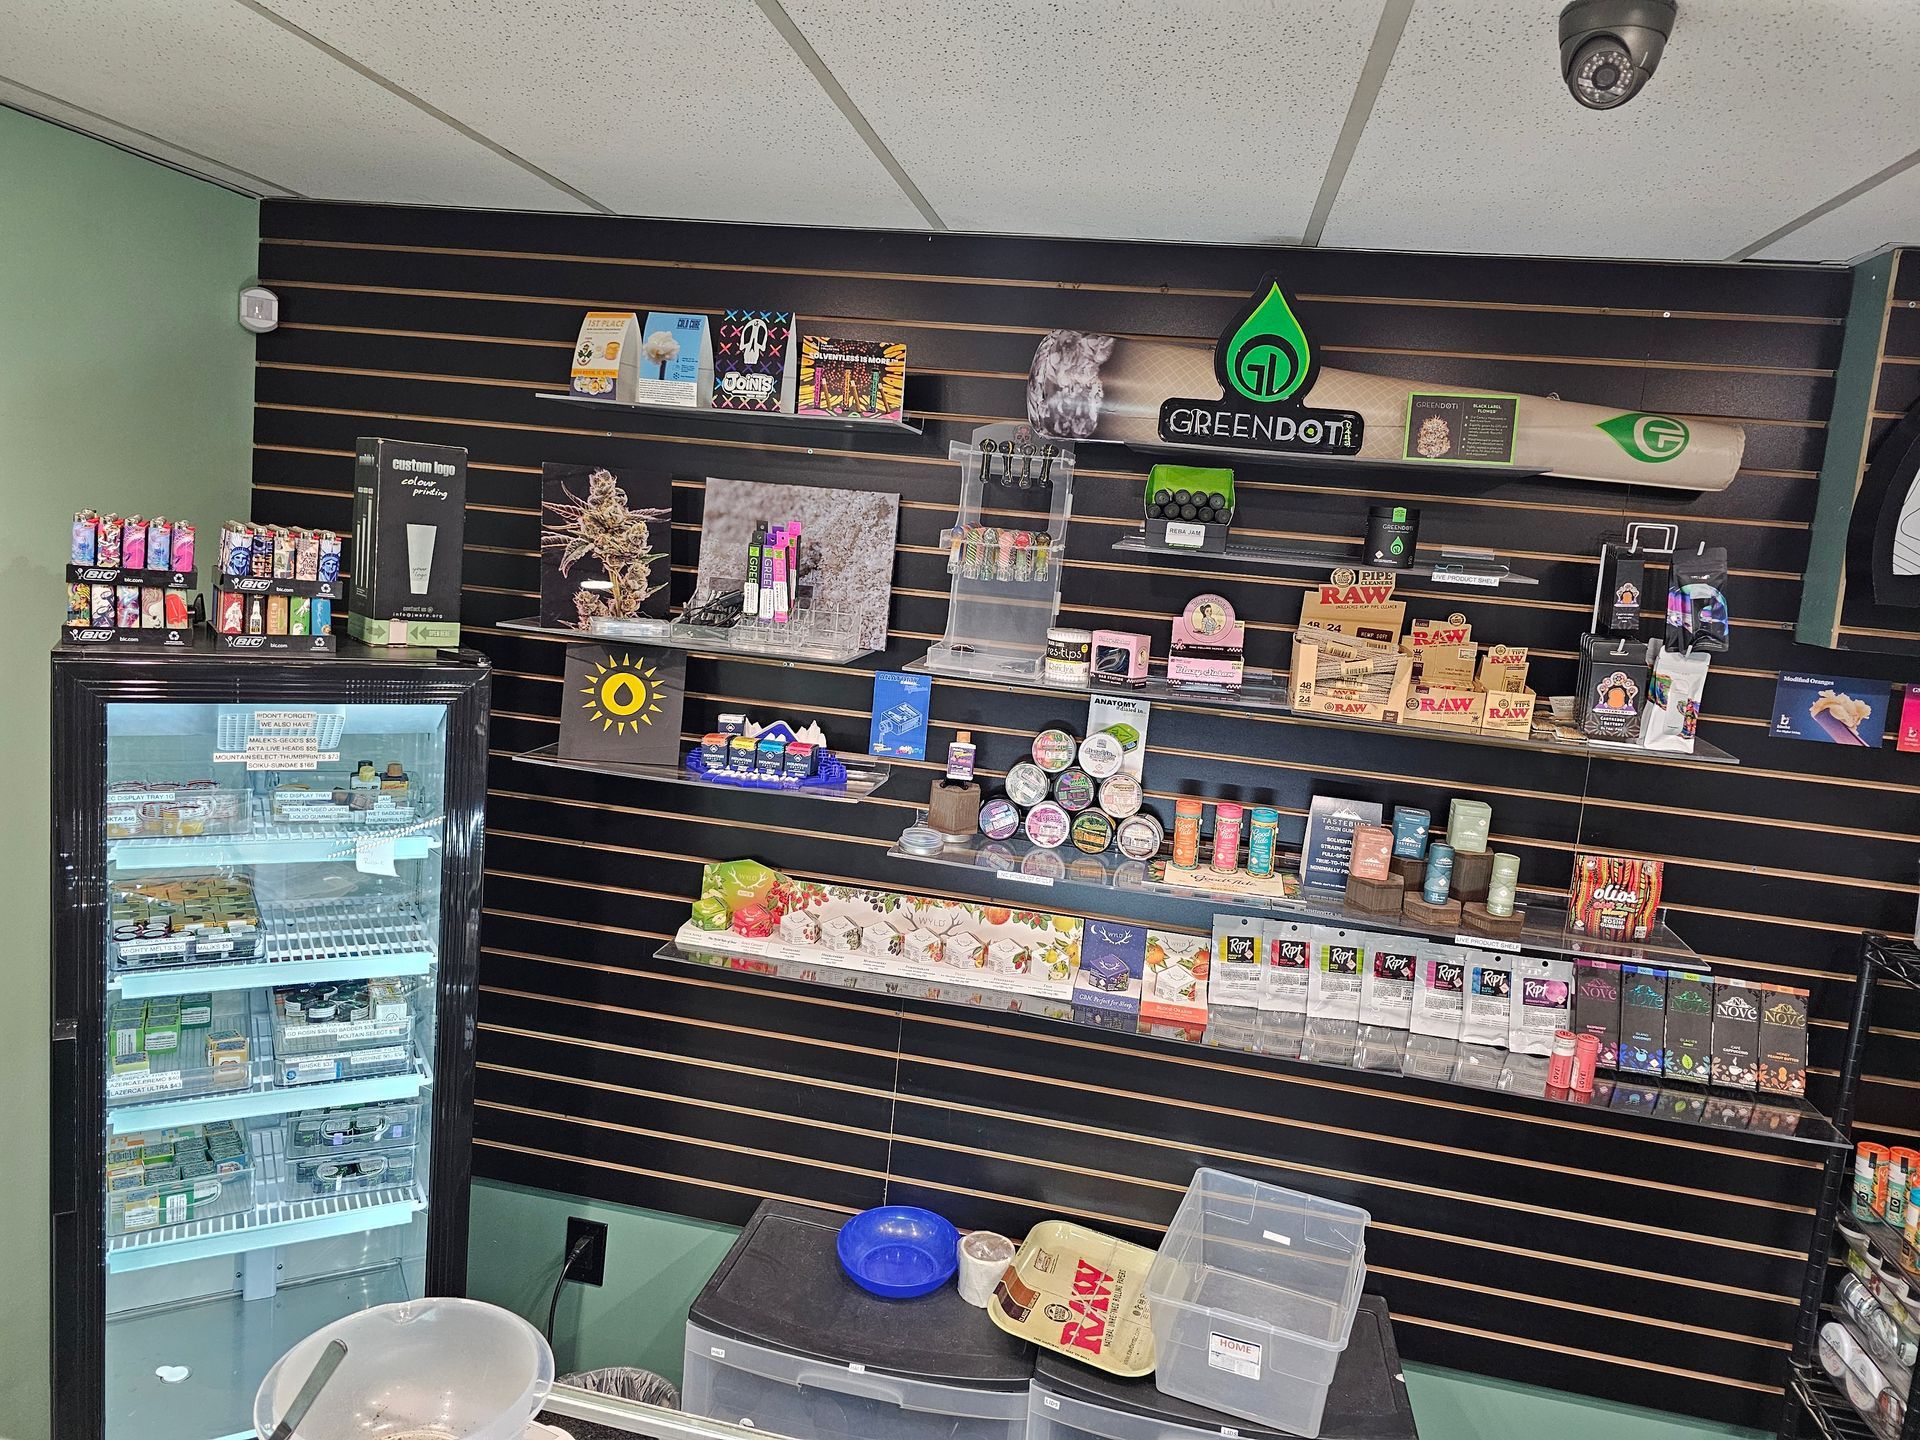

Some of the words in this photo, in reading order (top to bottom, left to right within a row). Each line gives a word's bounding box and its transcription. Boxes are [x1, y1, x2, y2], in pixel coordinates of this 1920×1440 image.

[588, 319, 600, 327] 1ST
[602, 320, 625, 328] PLACE
[810, 353, 859, 363] SOLVENTLESS
[392, 458, 432, 473] custom
[434, 461, 456, 477] logo
[401, 476, 436, 487] colour
[413, 488, 448, 500] printing
[85, 570, 114, 580] BIC
[1362, 571, 1393, 581] PIPE
[1446, 575, 1477, 583] PRODUCT
[240, 580, 267, 588] BIC
[1320, 586, 1392, 604] RAW
[1327, 623, 1342, 633] 24
[81, 630, 109, 639] BIC
[1413, 629, 1468, 646] RAW
[234, 637, 261, 646] BIC
[1490, 655, 1523, 664] RAW
[1300, 682, 1312, 690] 48
[1784, 676, 1810, 684] Modified
[1810, 678, 1834, 686] Oranges
[1095, 698, 1137, 708] ANATOMY
[1299, 695, 1311, 703] 24
[1334, 704, 1368, 713] RAW
[1420, 697, 1475, 712] RAW
[1489, 708, 1529, 719] RAW
[1310, 865, 1340, 873] MINIMALLY
[1593, 884, 1638, 903] olios
[919, 917, 946, 927] WYLD
[1600, 922, 1625, 930] GUMMIES
[1230, 938, 1251, 953] Ript
[1469, 938, 1499, 947] PRODUCT
[1281, 942, 1303, 958] Ript
[1332, 948, 1354, 964] Ript
[1385, 955, 1408, 970] Ript
[1438, 965, 1461, 980] Ript
[1483, 971, 1506, 986] Ript
[1525, 981, 1548, 997] Ript
[1111, 998, 1119, 1006] for
[1723, 1047, 1748, 1056] CAPPUCCINO
[110, 1087, 145, 1096] LAZERCAT
[1117, 1269, 1126, 1284] PAPERS
[1113, 1284, 1123, 1301] ROLLING
[1060, 1258, 1115, 1355] RAW
[1108, 1303, 1119, 1328] UNREFINED
[1104, 1329, 1114, 1347] NATURAL
[1219, 1338, 1253, 1355] HOME
[1045, 1398, 1059, 1408] LIDS
[1223, 1429, 1238, 1437] LIDS
